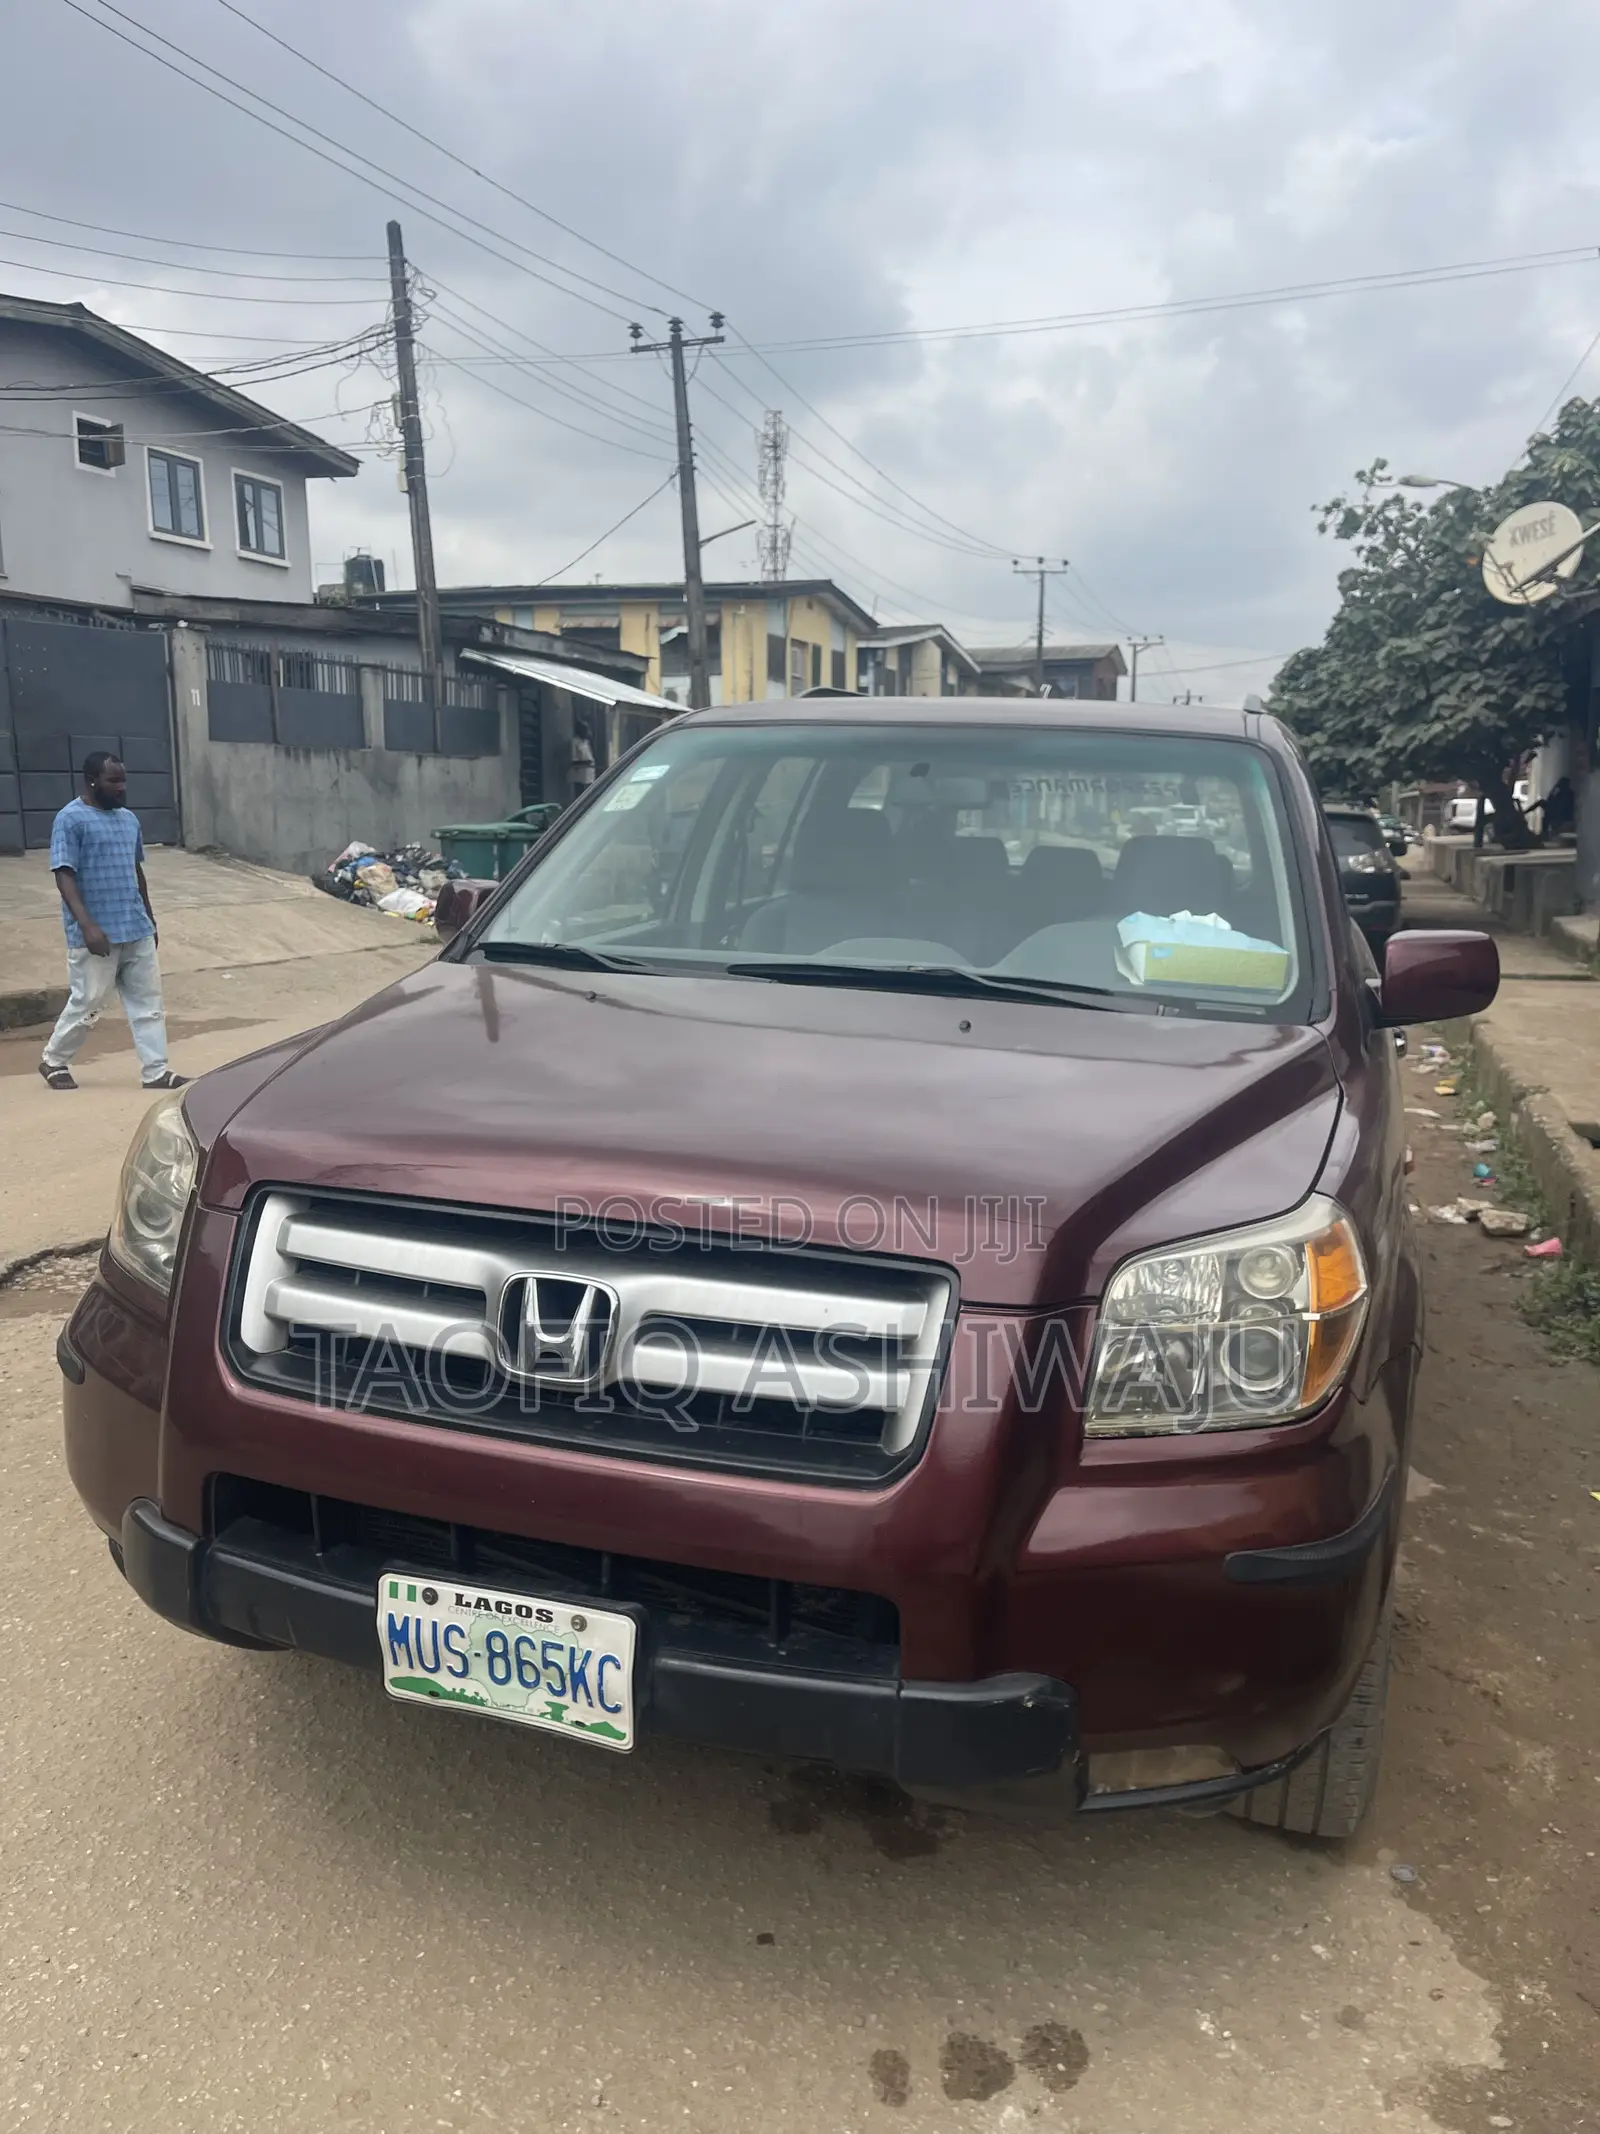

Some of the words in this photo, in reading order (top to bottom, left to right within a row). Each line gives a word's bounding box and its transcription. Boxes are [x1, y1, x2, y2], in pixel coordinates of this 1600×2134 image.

[190, 688, 201, 707] 11
[448, 1605, 483, 1619] CENTRE
[455, 1593, 554, 1623] LAGOS
